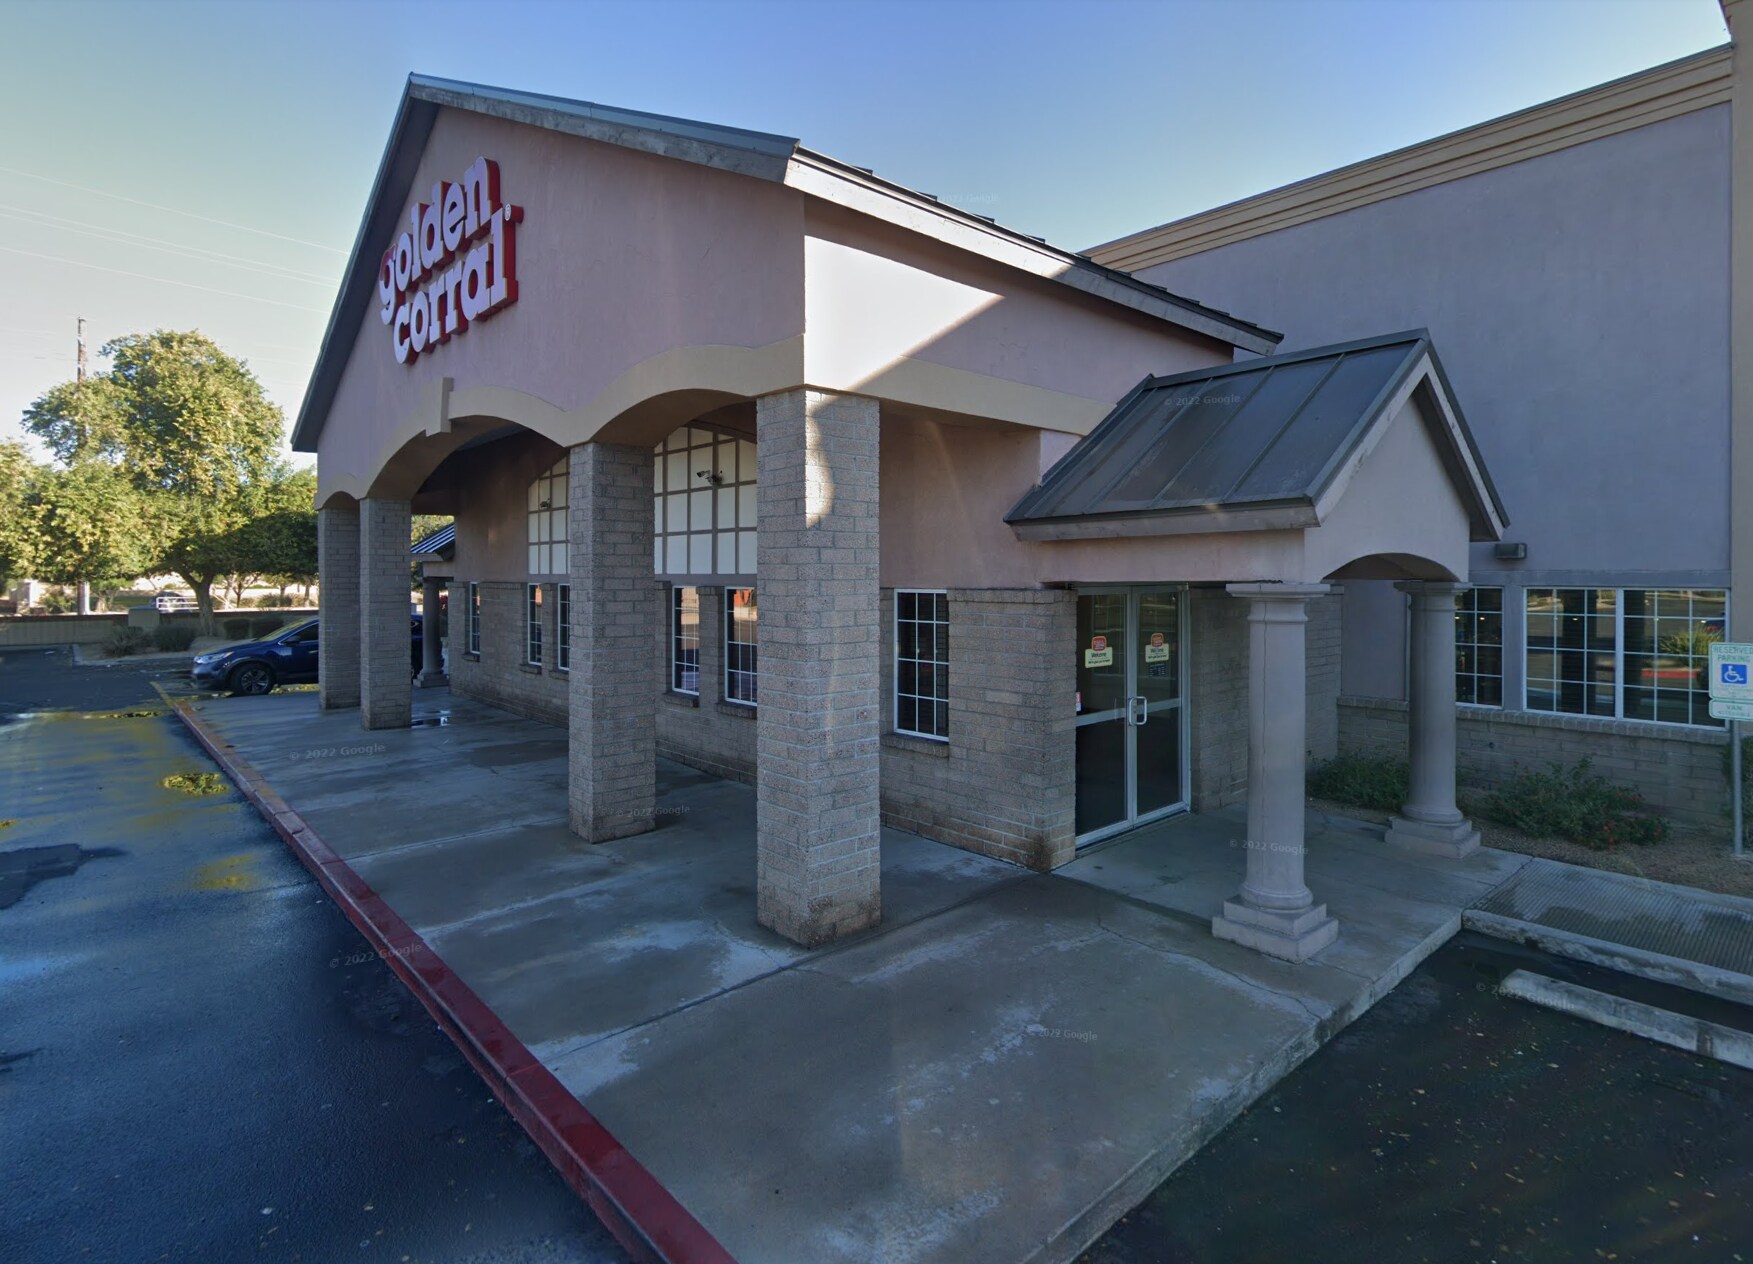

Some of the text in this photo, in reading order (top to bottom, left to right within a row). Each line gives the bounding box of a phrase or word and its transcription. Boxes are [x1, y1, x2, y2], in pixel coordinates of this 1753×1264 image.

[379, 156, 497, 325] golden
[393, 207, 512, 364] corral
[1718, 654, 1751, 663] PARKING
